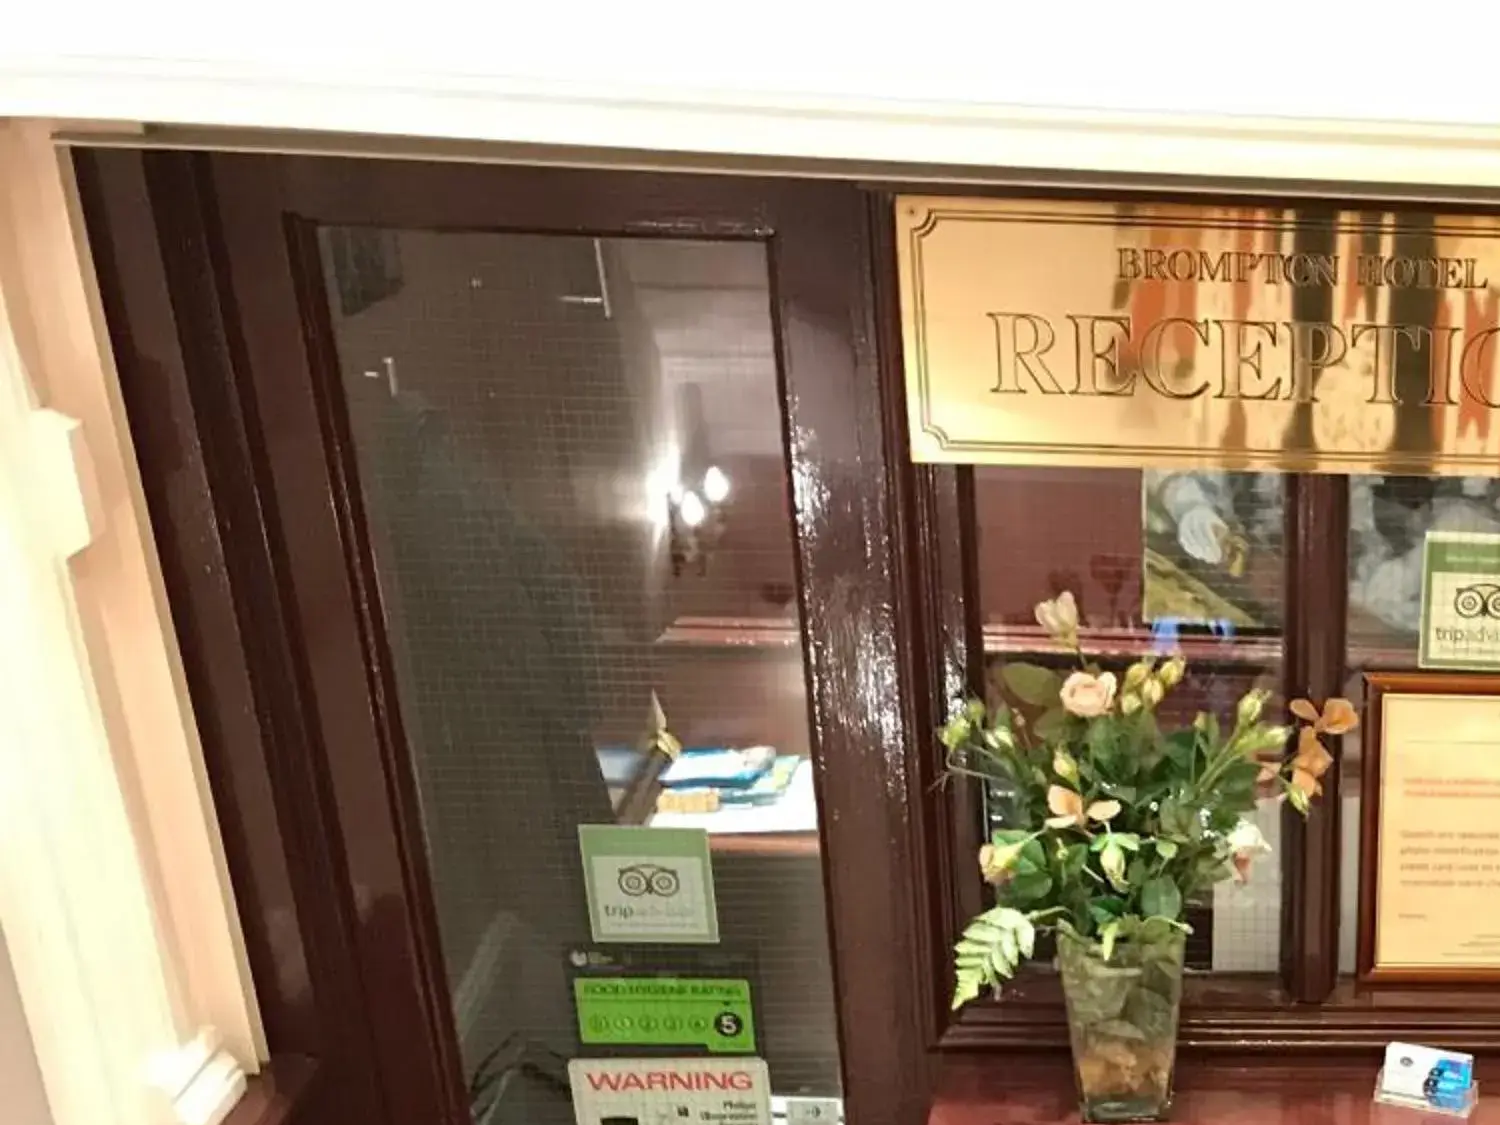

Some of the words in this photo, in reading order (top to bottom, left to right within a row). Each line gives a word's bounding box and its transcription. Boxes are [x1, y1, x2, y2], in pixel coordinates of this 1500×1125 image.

[1115, 246, 1339, 287] BROMPTON
[1355, 253, 1489, 291] HOTEL
[720, 1015, 738, 1035] 5
[585, 1071, 753, 1092] WARNING
